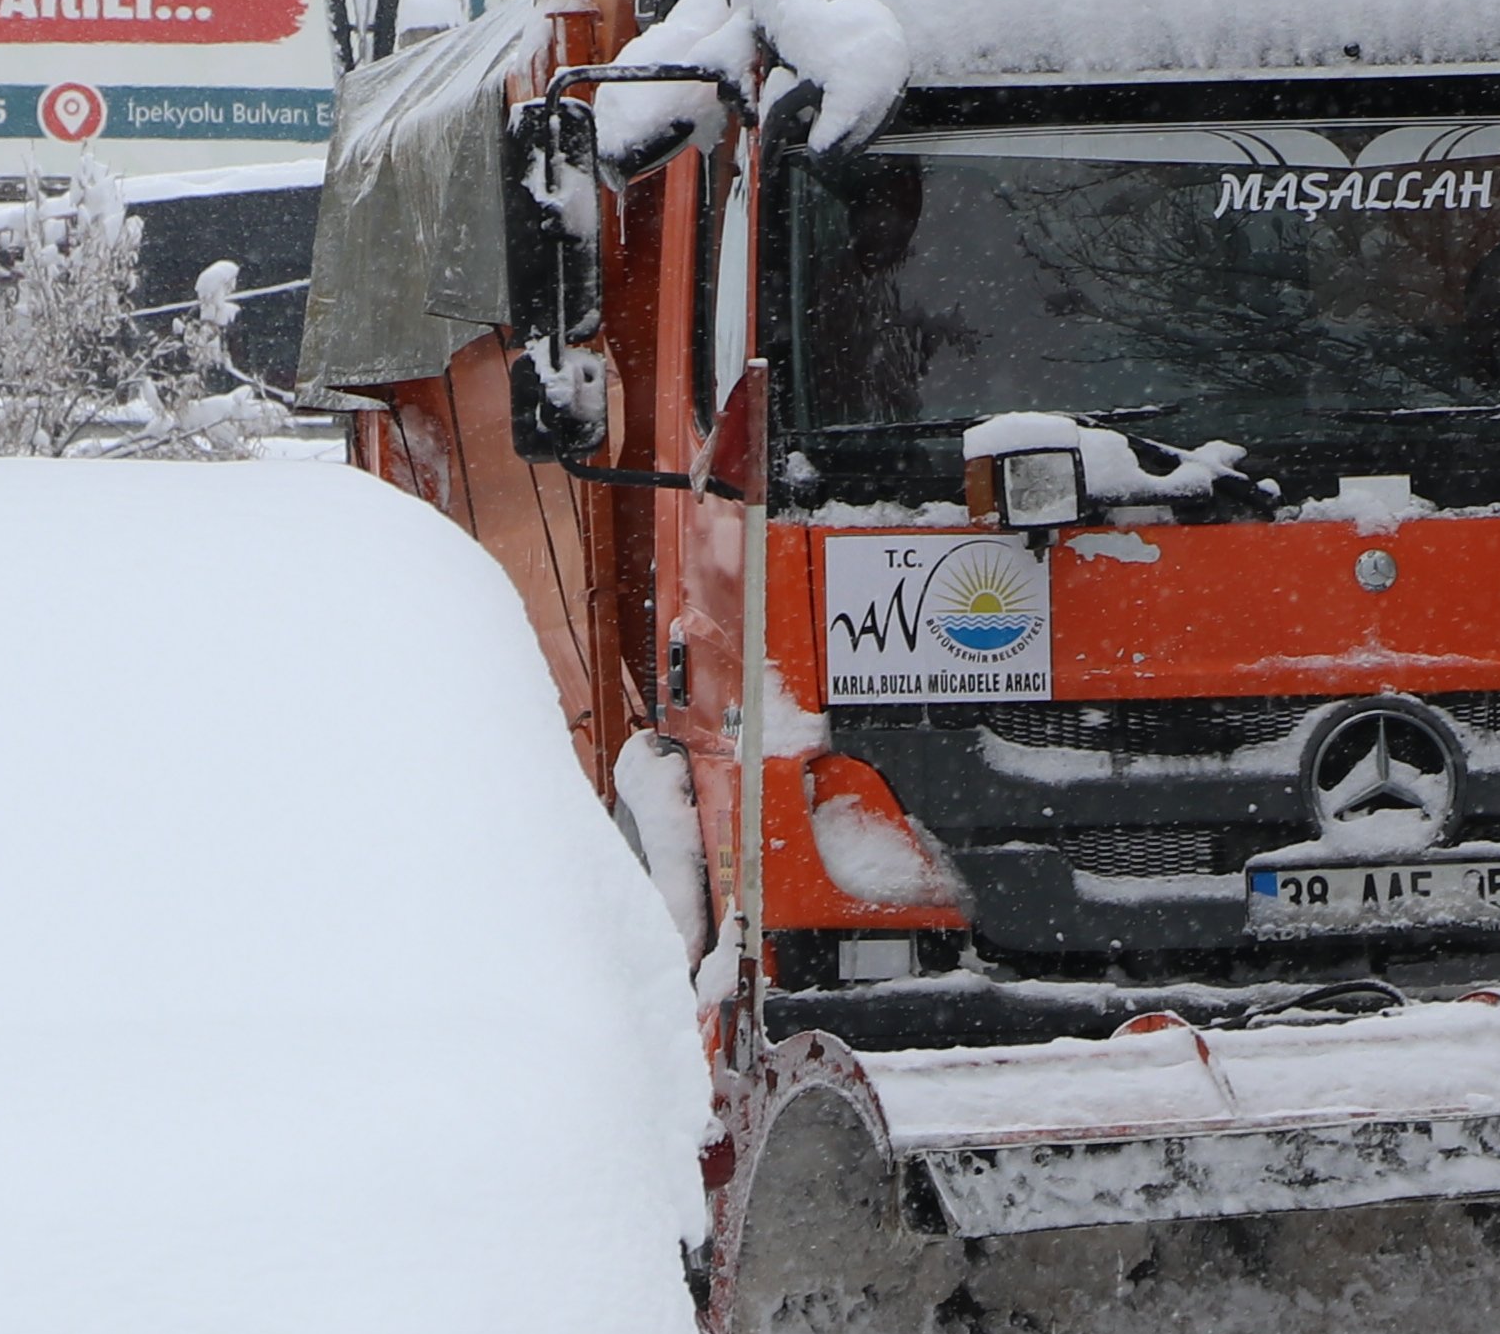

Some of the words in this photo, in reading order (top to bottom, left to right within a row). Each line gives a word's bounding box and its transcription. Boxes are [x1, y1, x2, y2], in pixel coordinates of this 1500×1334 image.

[127, 96, 224, 129] İpekyolu
[233, 101, 309, 127] Bulvarı
[1213, 170, 1494, 223] MAŞALLAH
[884, 548, 923, 568] T.C.
[925, 618, 989, 664] BÜYÜKŞEHİR
[991, 615, 1046, 663] BELEDİYESİ
[927, 669, 1000, 694] MÜCADELE
[1004, 672, 1046, 693] ARACI
